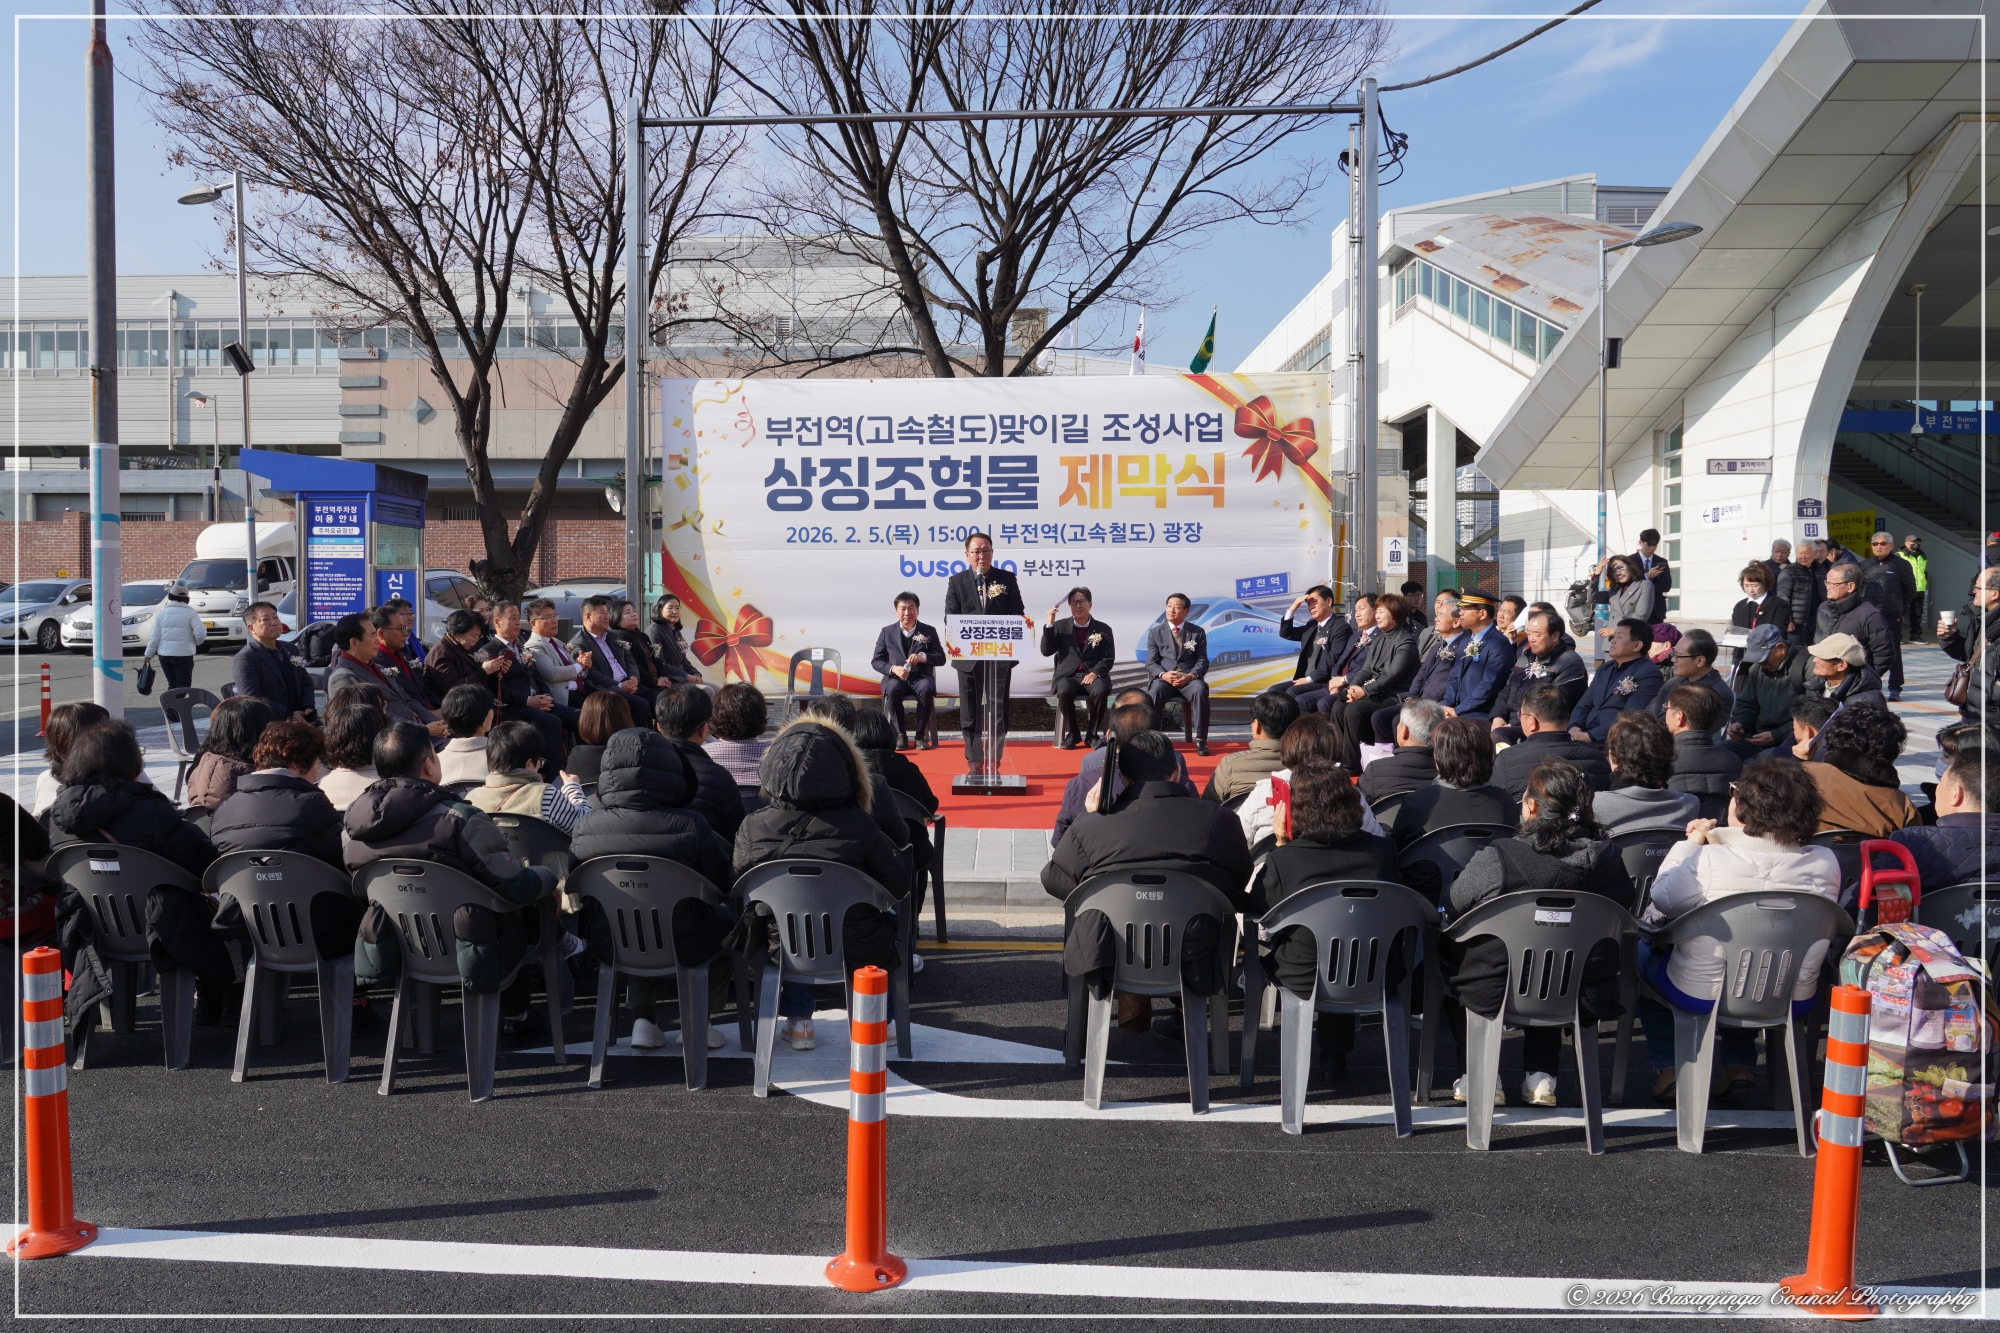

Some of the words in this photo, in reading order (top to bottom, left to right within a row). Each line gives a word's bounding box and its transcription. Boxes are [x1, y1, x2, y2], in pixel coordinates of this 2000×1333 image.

[765, 414, 1089, 446] 부전역(고속철도)맞이길
[1101, 412, 1224, 445] 조성사업
[764, 454, 1040, 512] 상징조형물
[1058, 452, 1226, 510] 제막식
[314, 506, 358, 514] 부전역주차장
[1802, 507, 1818, 516] 181
[786, 526, 838, 544] 2026.
[845, 526, 861, 544] 2.
[869, 524, 920, 545] 5.(목)
[927, 525, 980, 543] 15:00
[1000, 522, 1156, 544] 부전역(고속철도)
[1162, 521, 1203, 543] 광장
[1022, 559, 1086, 577] 부산진구
[1242, 577, 1280, 589] 부전역
[960, 626, 1023, 640] 상징조형물
[1242, 625, 1265, 633] KTX
[970, 641, 1013, 657] 제막식
[1547, 911, 1560, 921] 32
